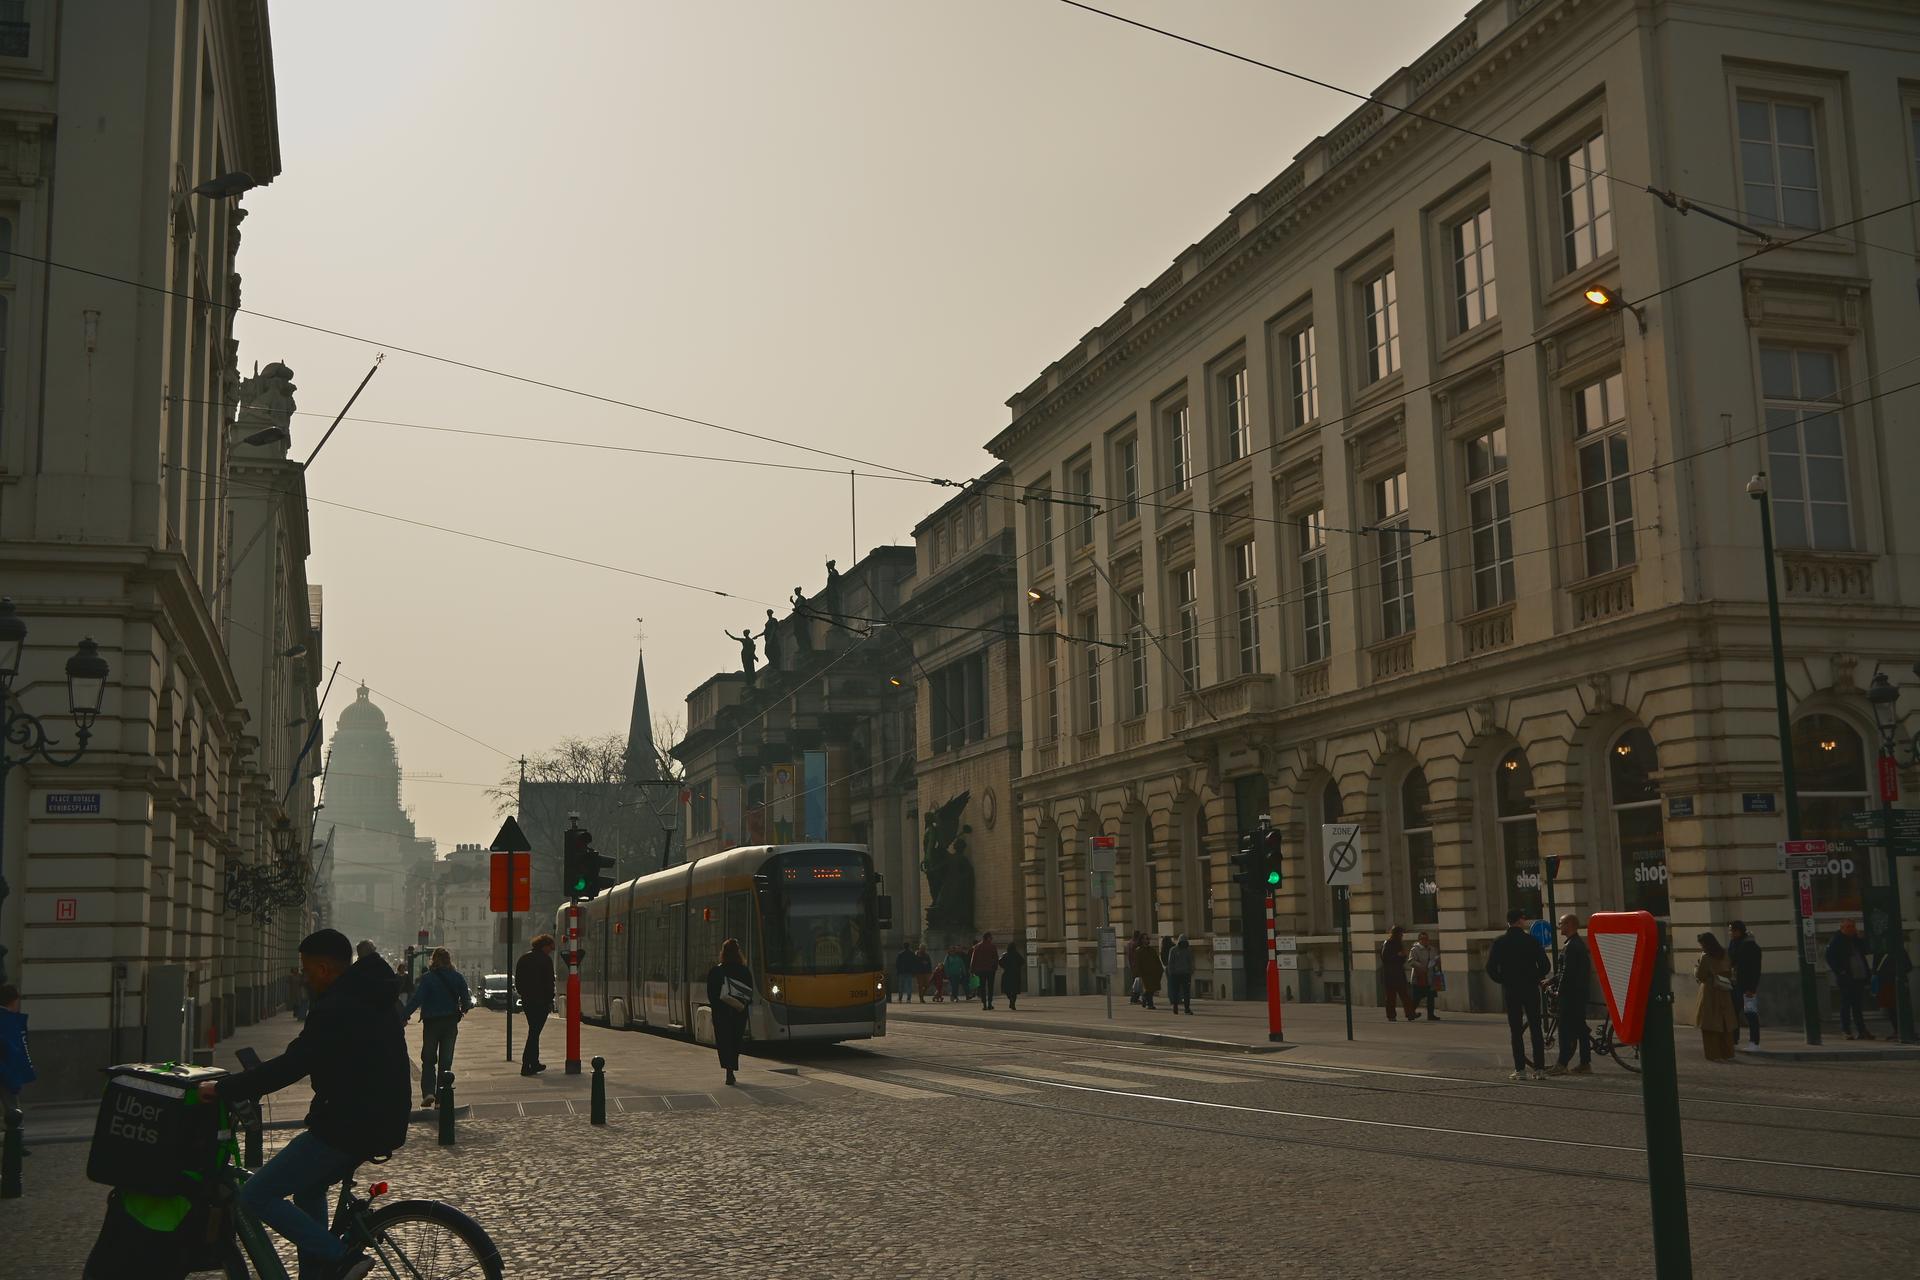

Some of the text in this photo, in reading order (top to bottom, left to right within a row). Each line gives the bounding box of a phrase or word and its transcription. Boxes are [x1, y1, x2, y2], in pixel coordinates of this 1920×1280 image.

[1332, 827, 1352, 836] ZONE
[1634, 862, 1667, 884] shop
[1419, 878, 1440, 897] sho
[116, 1092, 164, 1122] Uber
[110, 1115, 159, 1145] Eats
